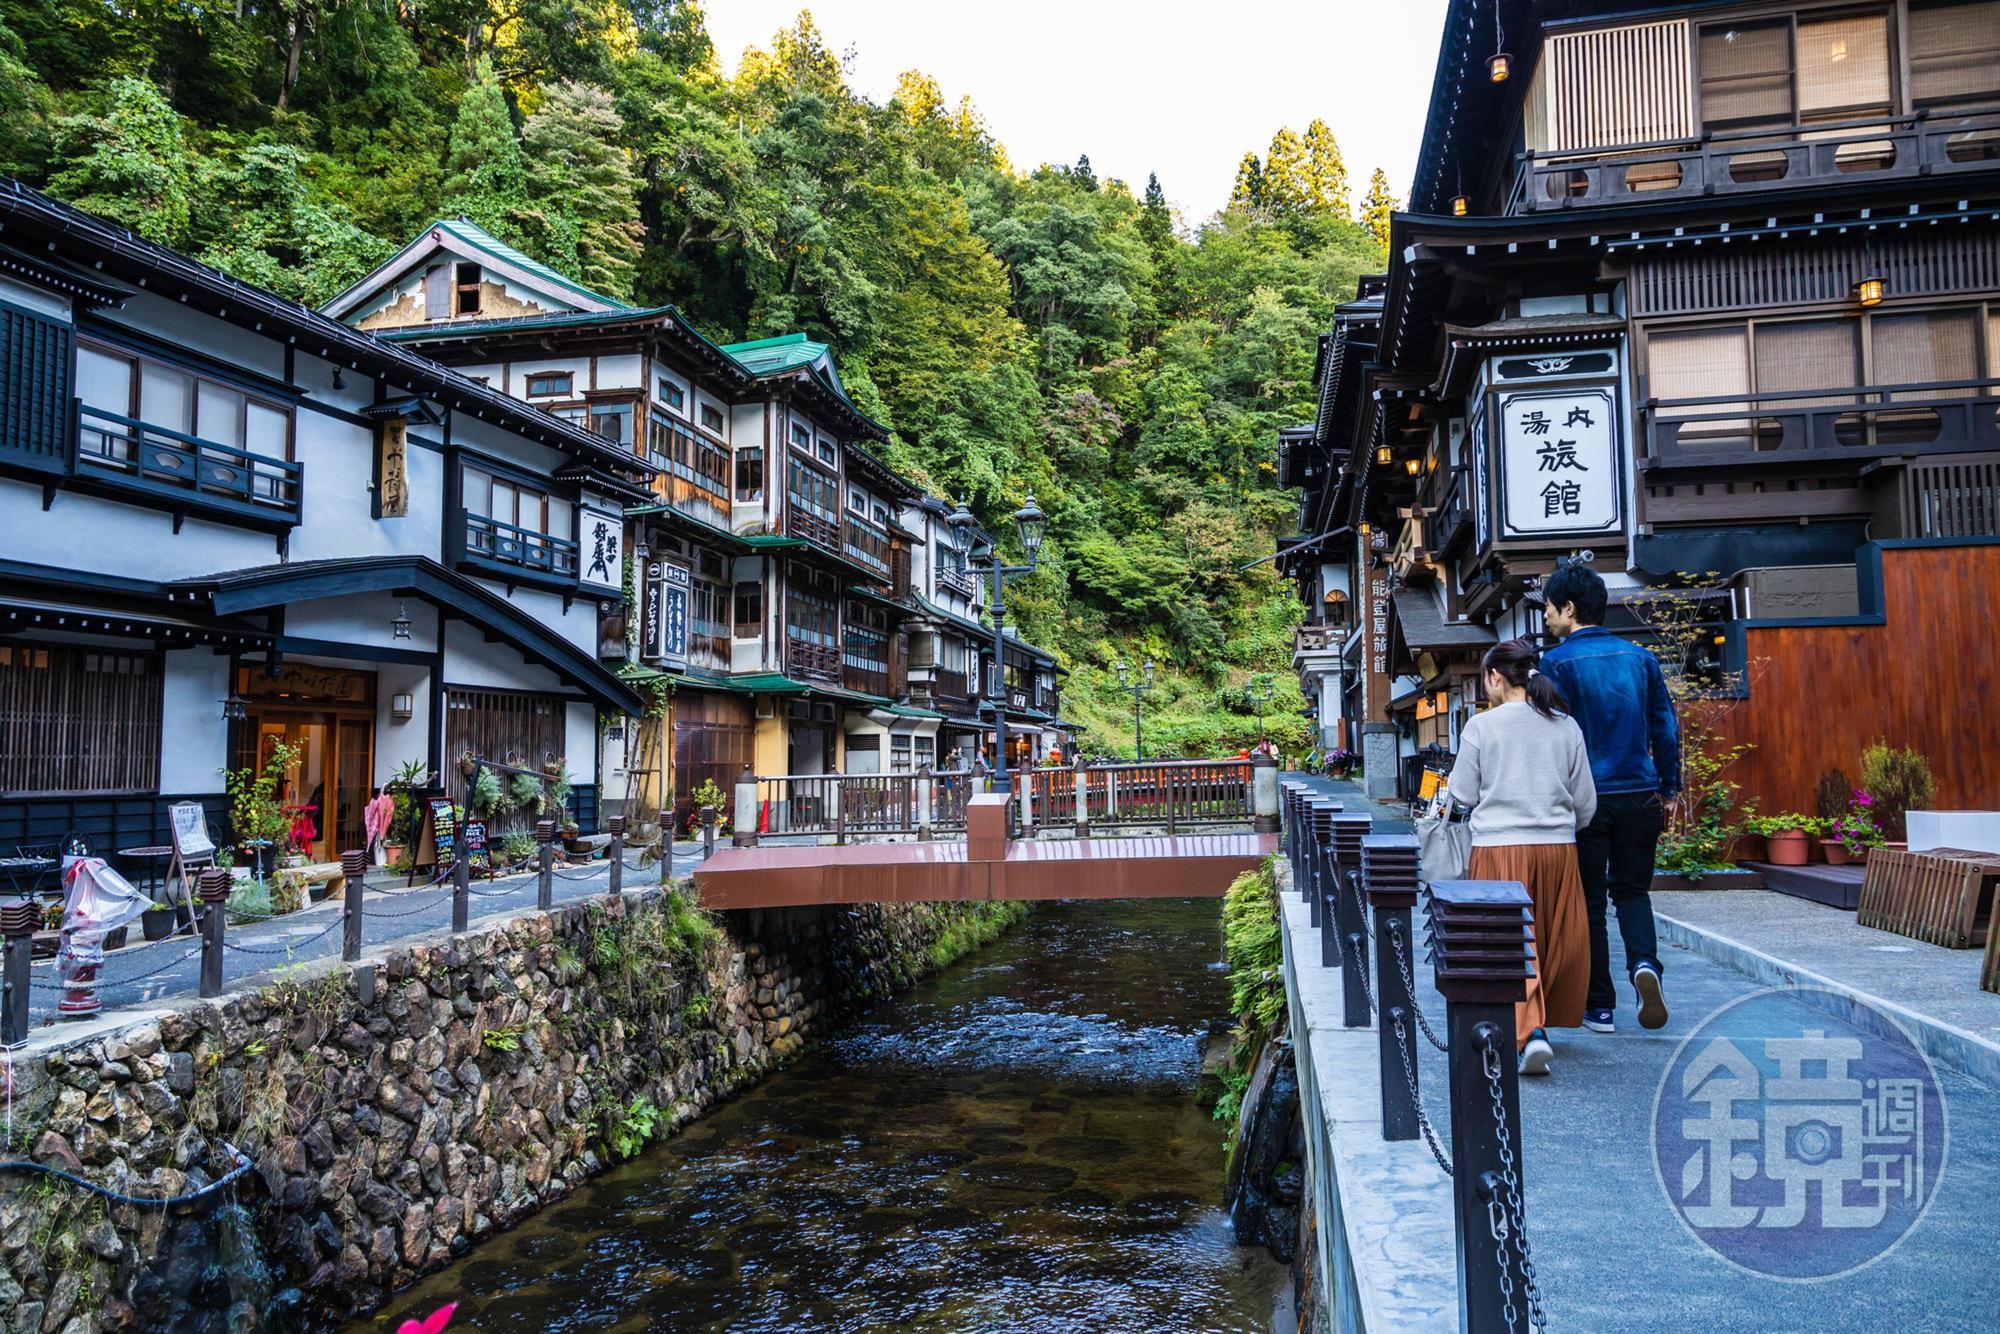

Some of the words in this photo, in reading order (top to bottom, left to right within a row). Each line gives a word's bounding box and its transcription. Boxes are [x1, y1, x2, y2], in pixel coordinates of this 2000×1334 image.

[1372, 579, 1387, 673] 能登屋旅館
